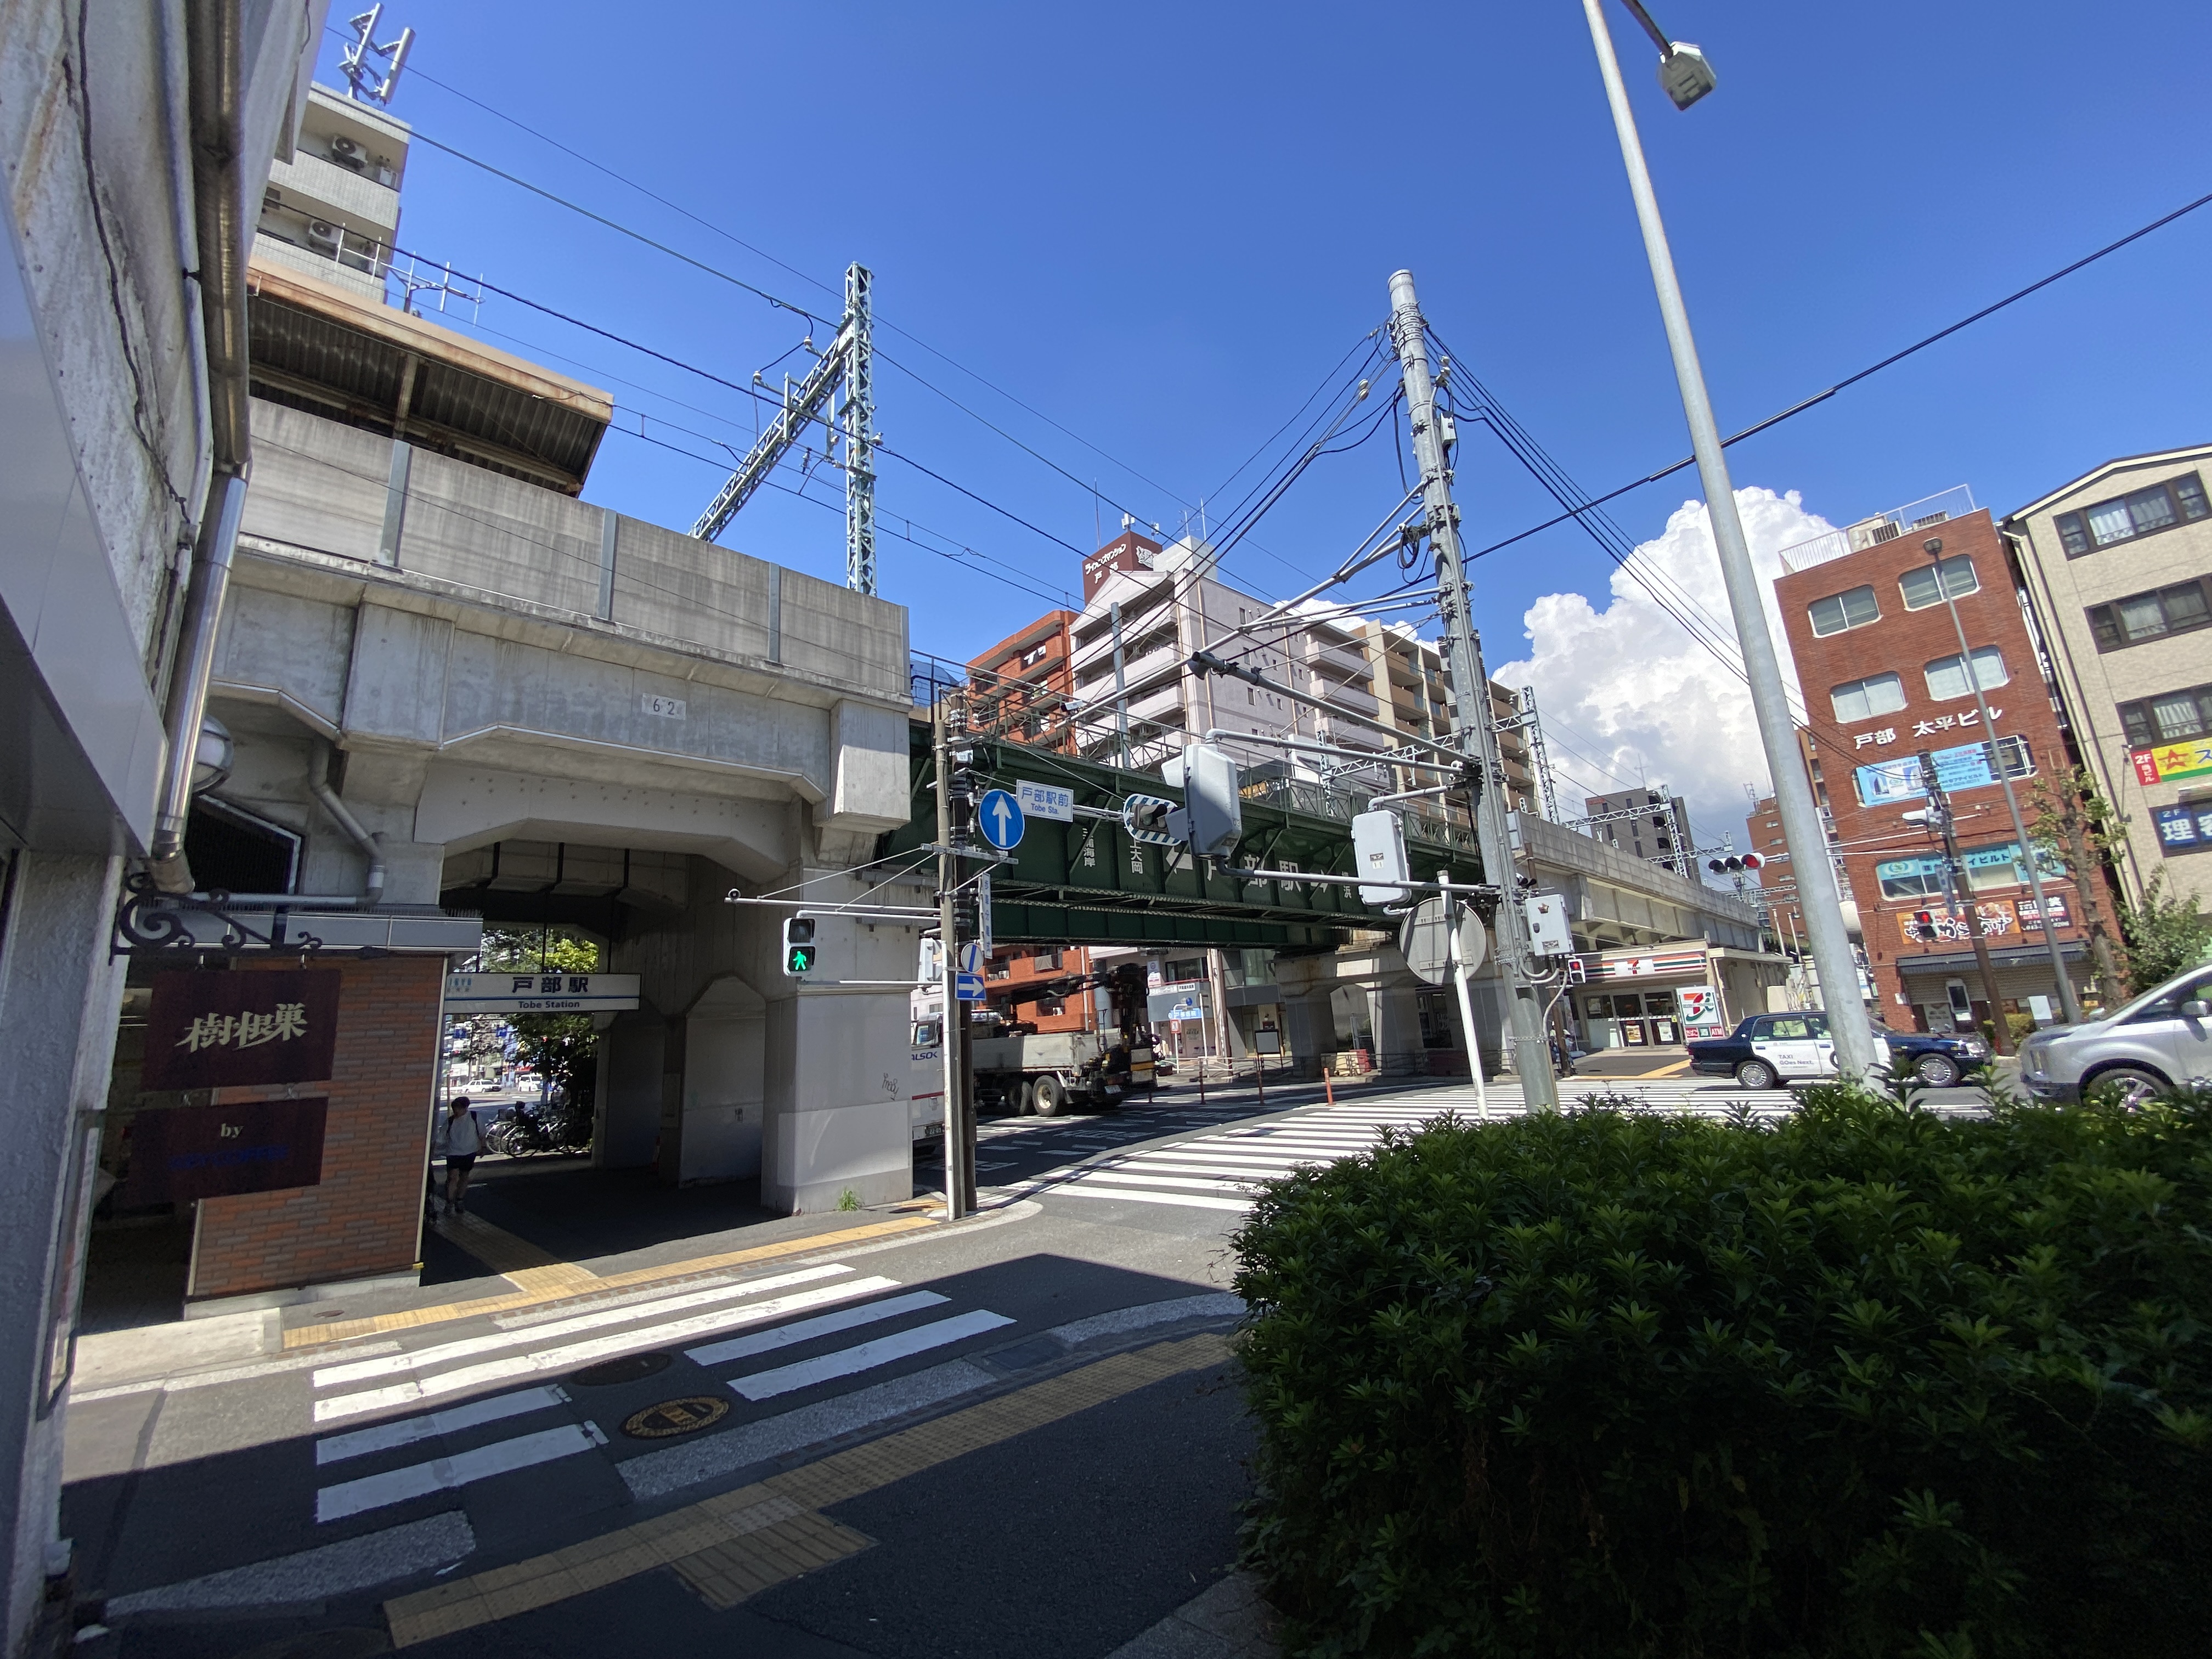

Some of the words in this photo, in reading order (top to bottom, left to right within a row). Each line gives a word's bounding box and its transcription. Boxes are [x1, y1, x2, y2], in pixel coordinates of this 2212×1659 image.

[653, 698, 675, 716] 62
[1853, 727, 1897, 751] 戸部
[1911, 706, 2002, 738] 太平ビル
[2135, 753, 2152, 765] 2F
[1021, 786, 1069, 808] 戸部駅前
[1031, 803, 1046, 812] Tobe
[1048, 805, 1060, 815] Sta.
[2163, 809, 2181, 818] 2F
[1129, 838, 1143, 874] 上大岡
[511, 976, 589, 994] 戸部駅
[518, 1000, 542, 1009] Tobe
[545, 1000, 580, 1009] Station
[1711, 1028, 1723, 1036] ATM
[220, 1123, 245, 1139] by
